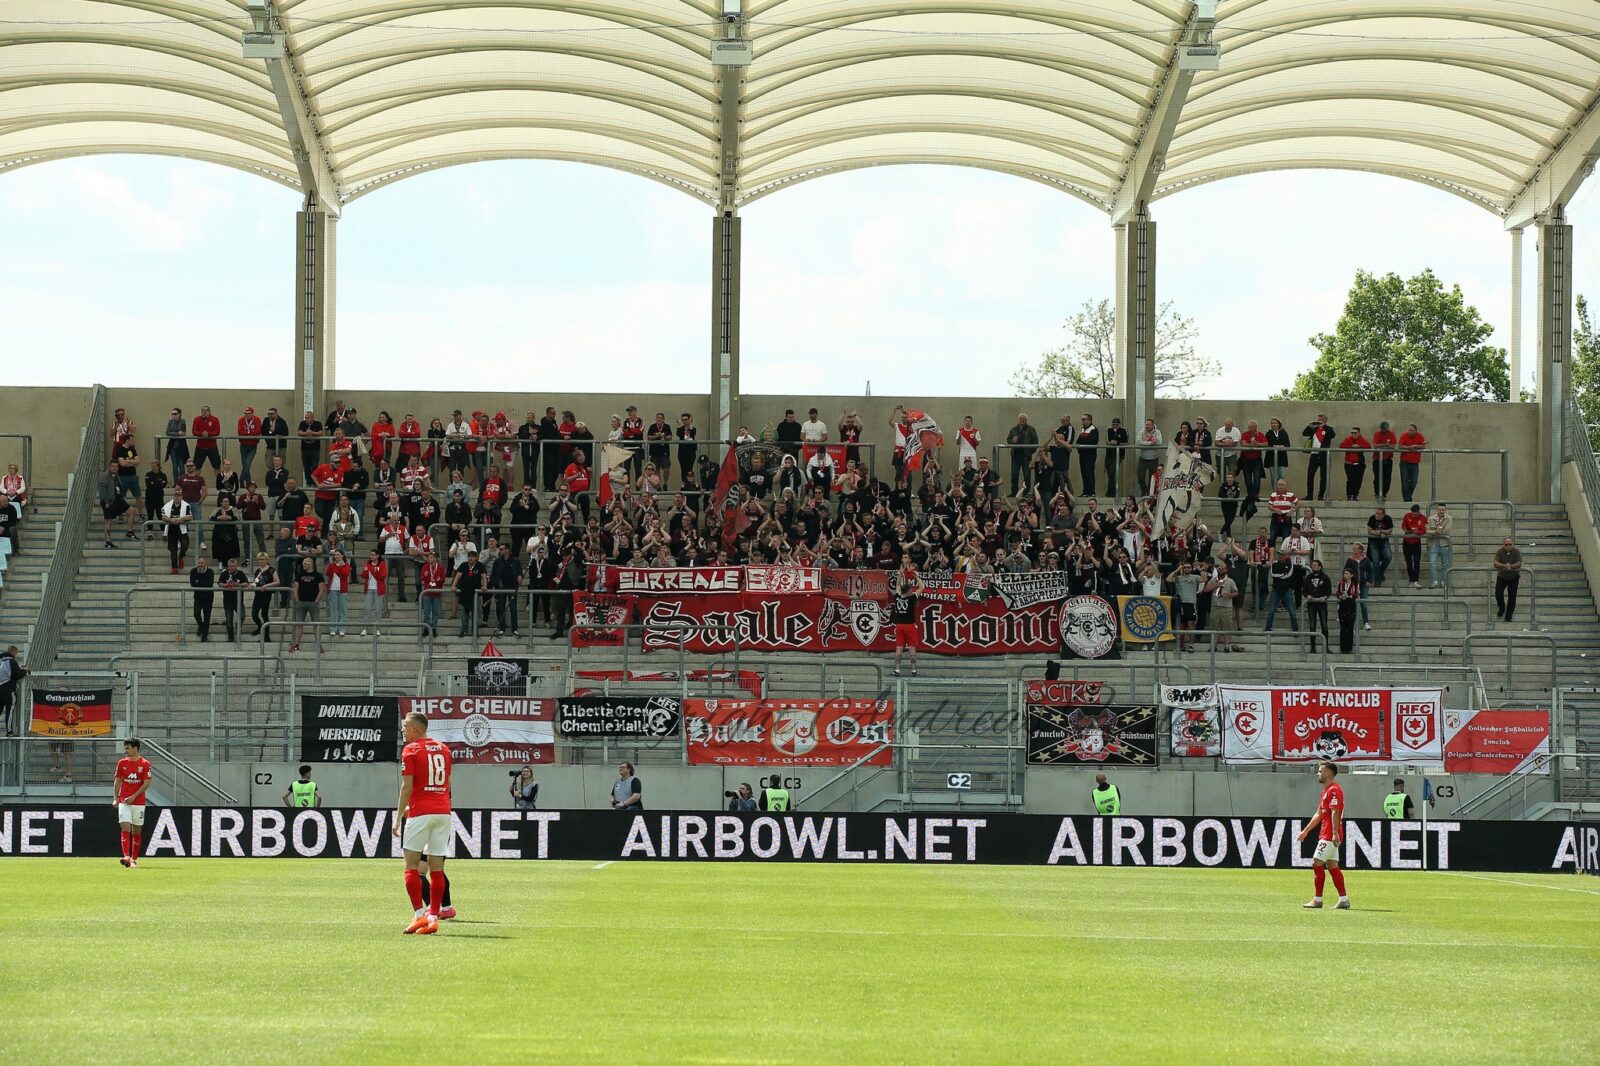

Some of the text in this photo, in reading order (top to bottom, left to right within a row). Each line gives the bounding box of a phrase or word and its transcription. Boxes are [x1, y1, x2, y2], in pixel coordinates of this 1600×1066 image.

[619, 571, 739, 590] SURREALE
[907, 578, 962, 590] MNSFELD
[1000, 571, 1064, 583] ELEKOM
[919, 592, 957, 602] DHARZ
[854, 603, 875, 612] HFC
[643, 599, 814, 647] Saale
[920, 603, 1058, 649] front
[45, 694, 96, 702] Ostdeutschland
[657, 697, 677, 711] HFC
[1282, 692, 1310, 707] HFC
[1319, 692, 1381, 708] FANCLUB
[317, 704, 383, 719] DOMFALKEN
[410, 698, 542, 716] HFC CHEMIE
[561, 703, 614, 718] Libertà
[1234, 702, 1257, 711] HFC
[1399, 704, 1431, 715] HFC
[561, 719, 650, 733] Chemie Halle
[685, 715, 892, 748] Halle Ost
[318, 728, 382, 742] MERSEBURG
[1032, 730, 1066, 739] Fanclub
[756, 756, 834, 764] Legende
[427, 753, 446, 786] 18
[254, 773, 273, 785] C2
[783, 777, 802, 790] C3
[949, 774, 971, 788] C2
[1435, 785, 1454, 798] C3
[145, 808, 561, 860] AIRBOWLNET
[621, 814, 987, 861] AIRBOWL.NET
[1047, 816, 1461, 870] AIRBOWLNET
